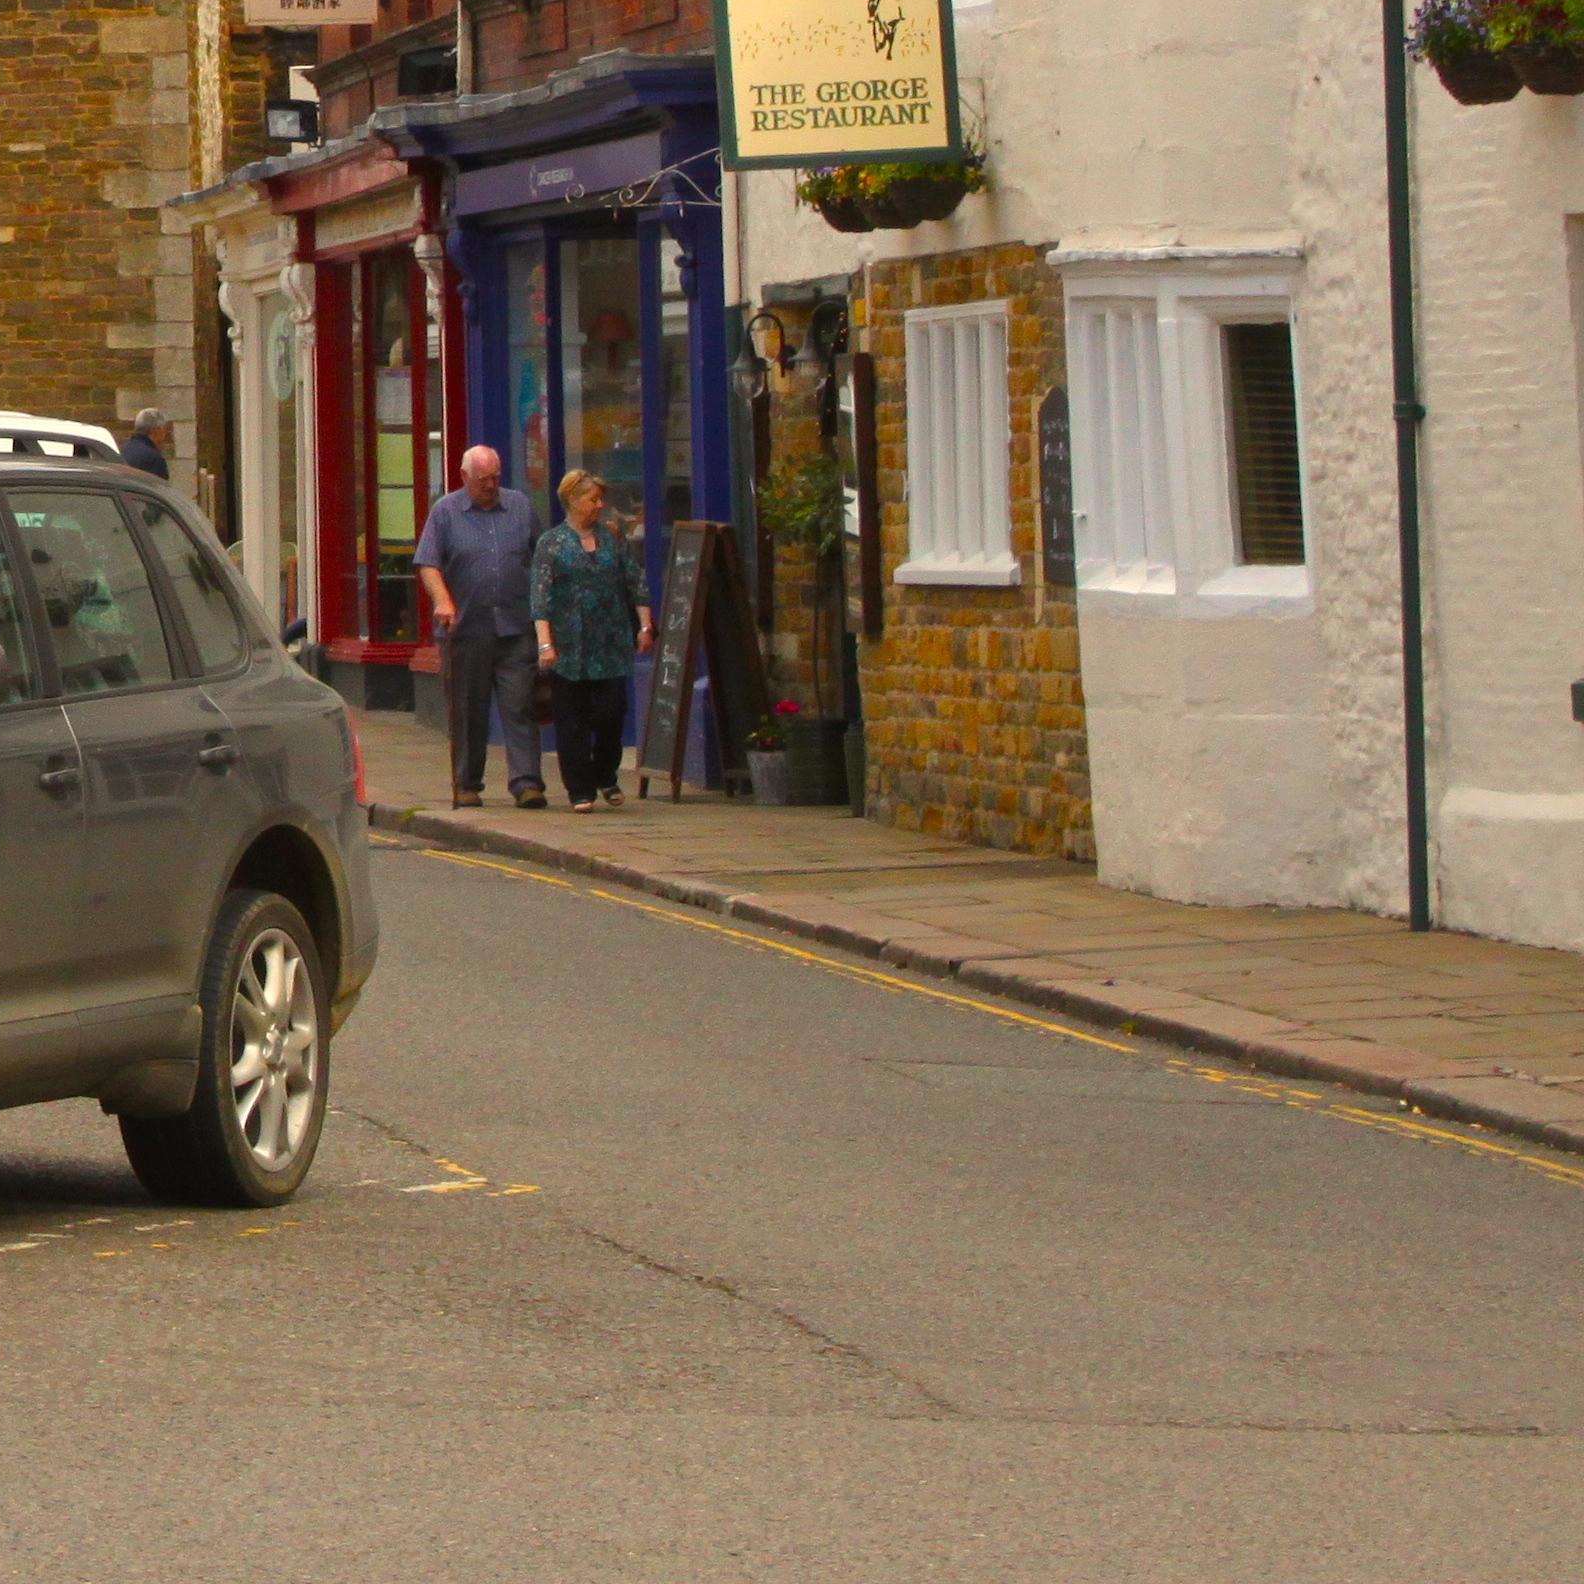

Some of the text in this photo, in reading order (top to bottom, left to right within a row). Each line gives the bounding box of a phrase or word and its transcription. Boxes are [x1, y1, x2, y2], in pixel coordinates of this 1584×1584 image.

[750, 77, 929, 106] THE GEORGE
[751, 102, 932, 132] RESTAURANT
